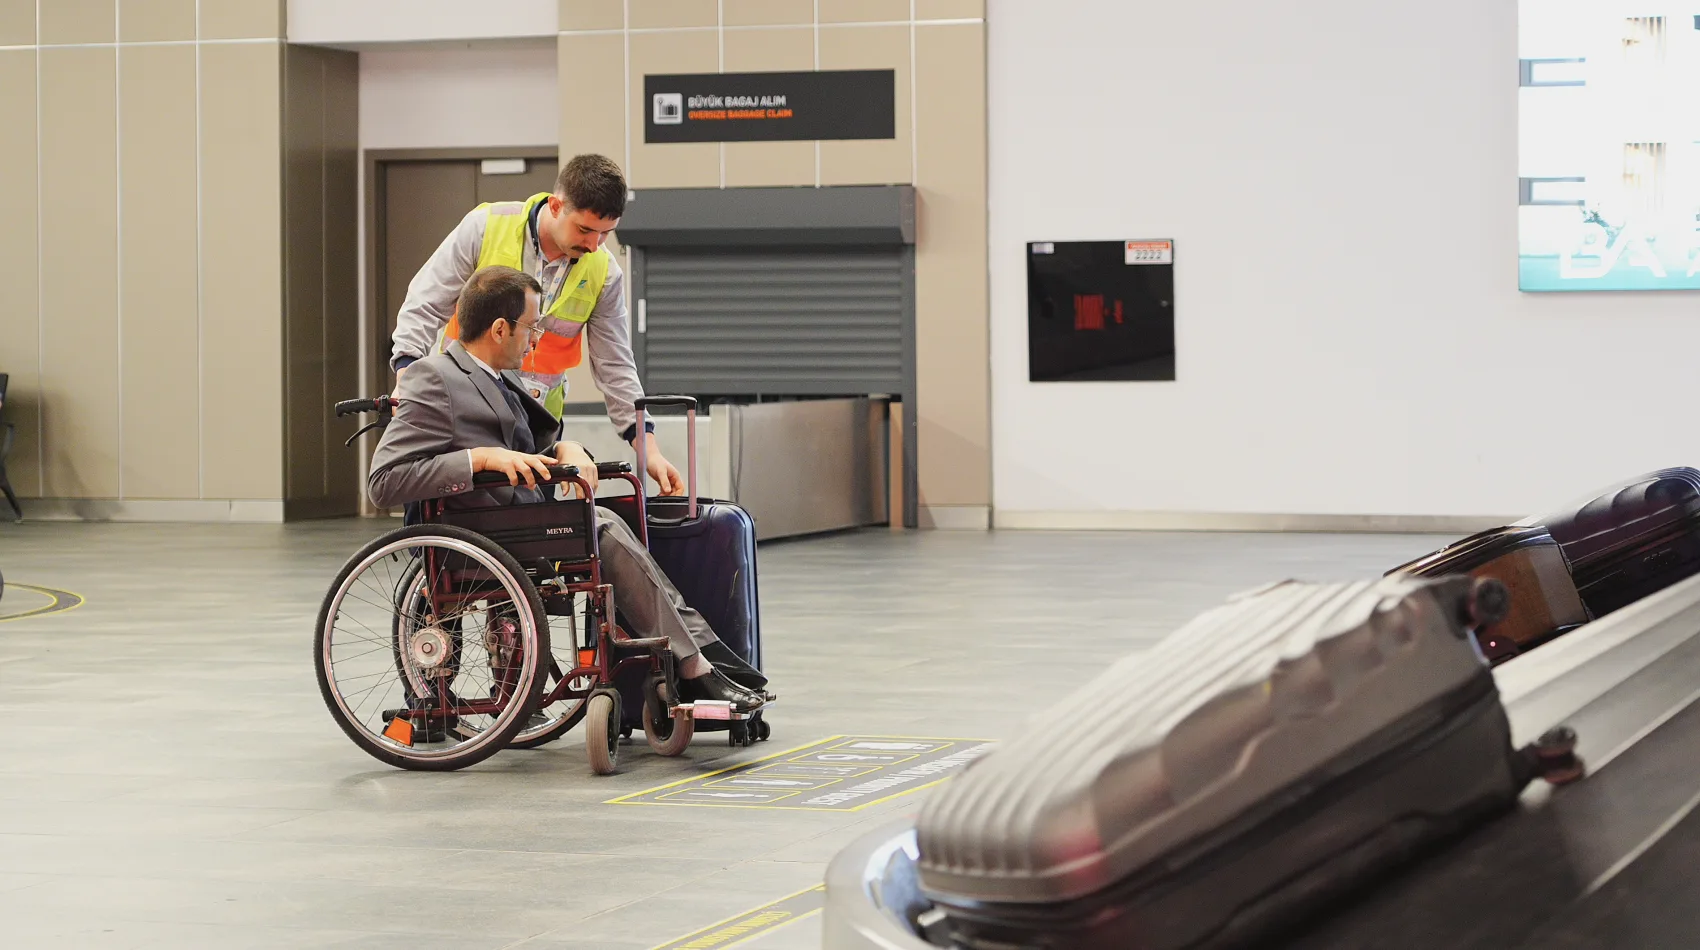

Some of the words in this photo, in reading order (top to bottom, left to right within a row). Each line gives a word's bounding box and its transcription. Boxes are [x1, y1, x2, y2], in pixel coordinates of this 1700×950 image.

[687, 95, 724, 108] BÜYÜK
[725, 95, 760, 108] BAGAJ
[688, 110, 727, 120] OVERSIZE
[727, 109, 767, 120] BAGGAGE
[766, 109, 793, 119] CLAIM
[546, 527, 573, 535] MEYRA
